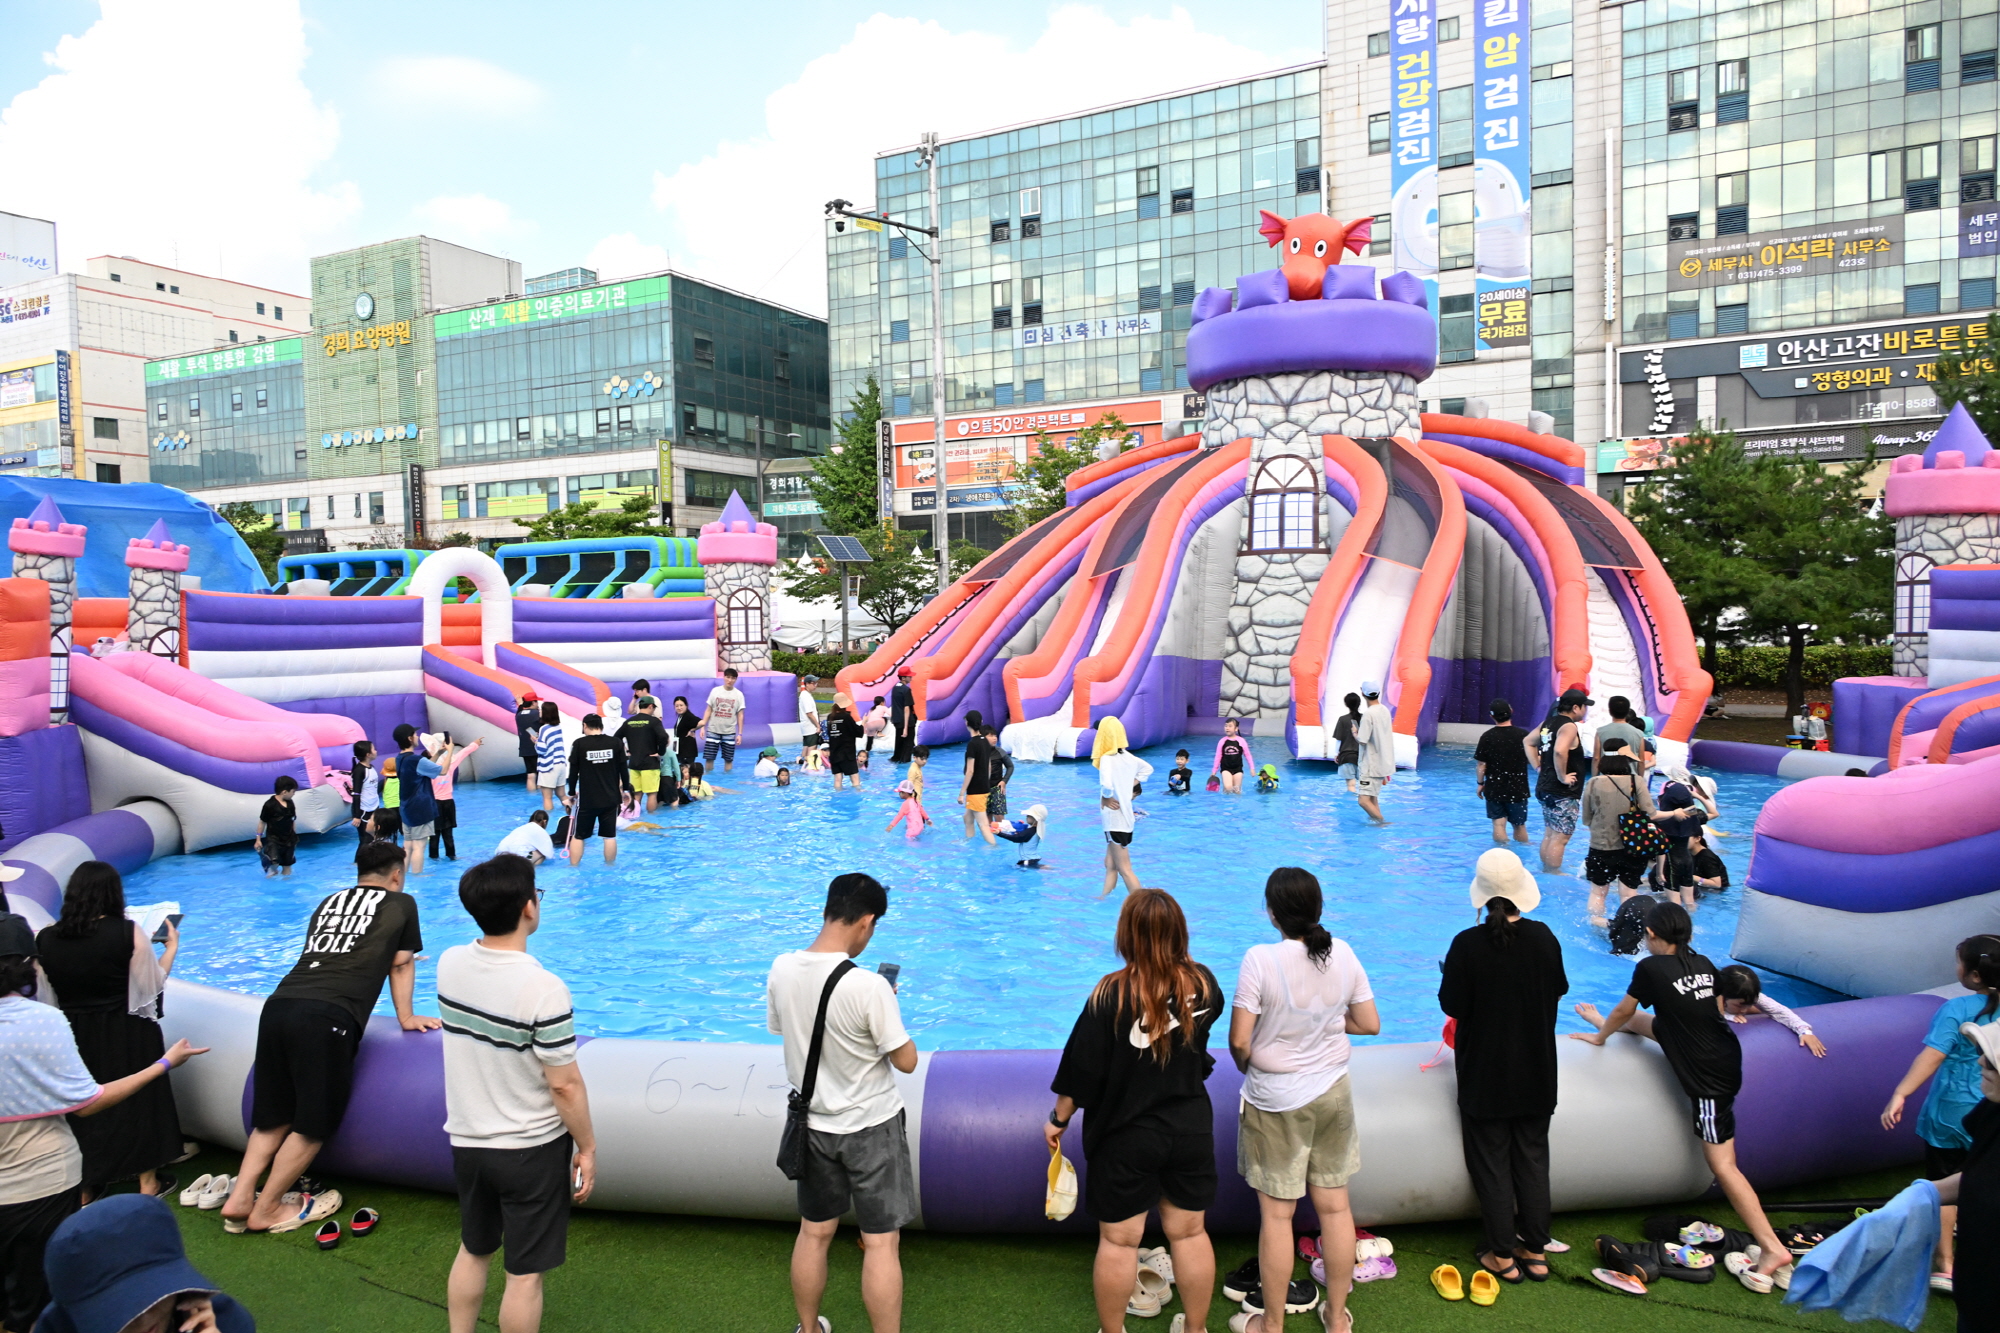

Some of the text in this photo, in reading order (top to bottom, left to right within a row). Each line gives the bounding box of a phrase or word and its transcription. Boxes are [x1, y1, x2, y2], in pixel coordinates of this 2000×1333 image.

[1396, 50, 1433, 166] 건강검진
[1969, 213, 1998, 226] 세무
[1968, 230, 1998, 245] 법인
[22, 256, 51, 270] 안산
[1707, 237, 1891, 272] 세무사 이석락 사무소
[1738, 265, 1802, 280] 031)475-3399
[1838, 257, 1867, 268] 423호
[1479, 287, 1526, 303] 20세이상
[468, 285, 627, 329] 산재 재활 인증의료기관
[1478, 300, 1528, 326] 무료
[1116, 318, 1151, 333] 사무소
[1478, 323, 1527, 340] 국가검진
[322, 320, 412, 357] 경희요양병원
[158, 344, 275, 378] 재활 투석 암통합 감염
[1811, 367, 1893, 391] 정형외과
[1186, 396, 1205, 408] 세무
[970, 413, 1070, 434] 으뜸50안경콘택트
[1744, 439, 1778, 450] 프리미엄
[320, 888, 387, 915] AIR
[304, 933, 360, 954] SOLE
